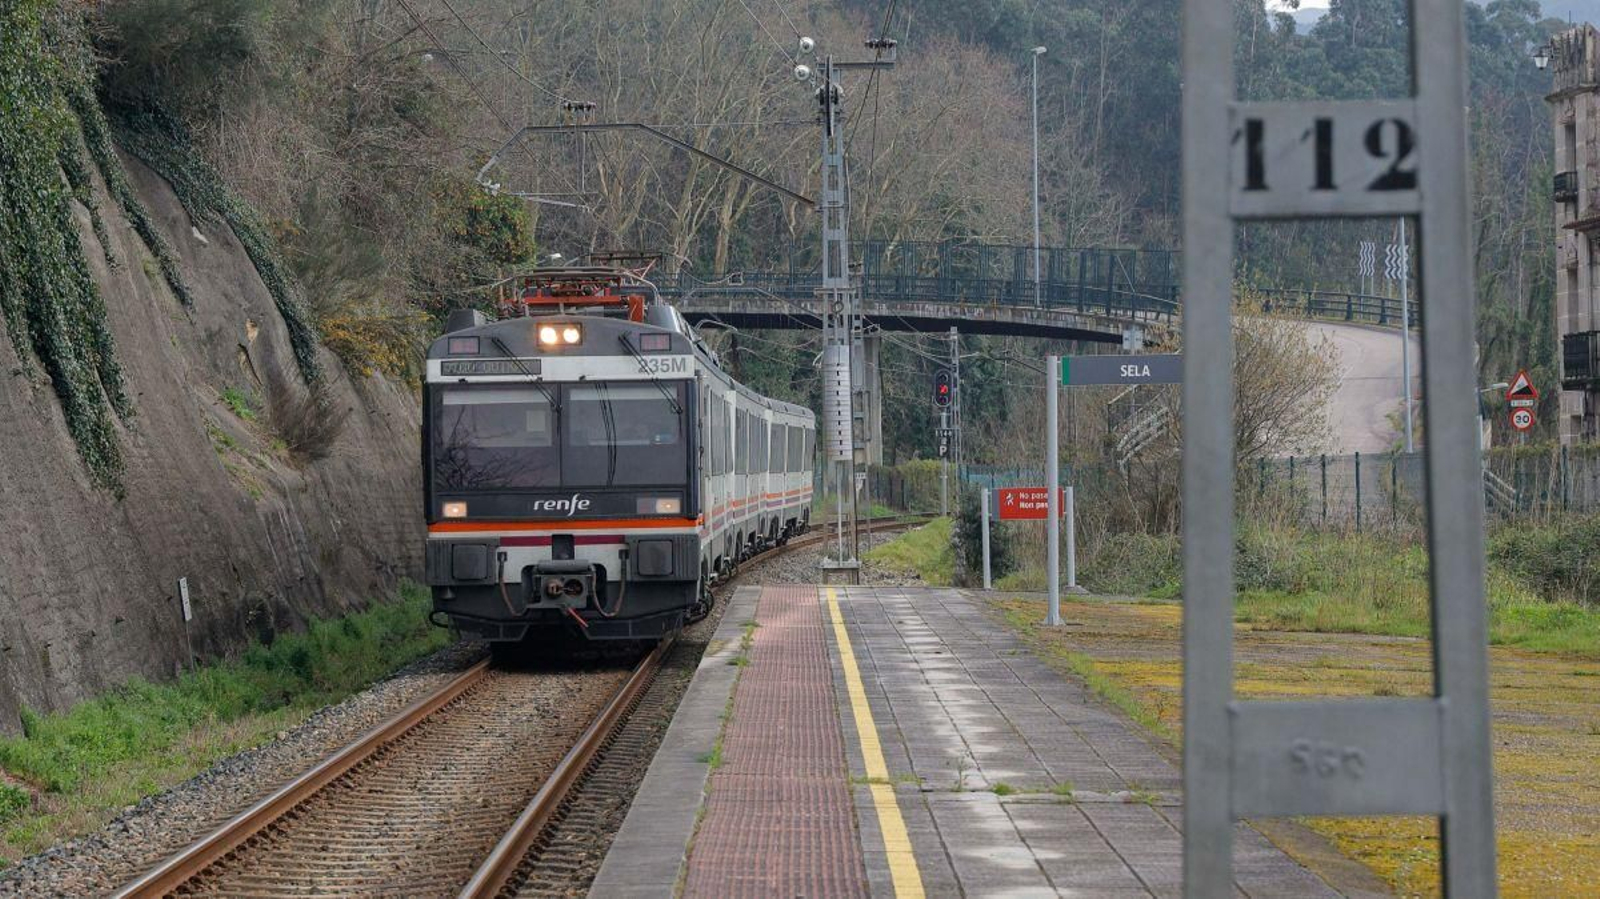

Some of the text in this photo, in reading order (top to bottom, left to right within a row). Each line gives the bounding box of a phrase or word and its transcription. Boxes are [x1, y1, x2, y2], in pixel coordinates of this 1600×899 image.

[1230, 117, 1417, 191] 112
[638, 357, 686, 373] 235M
[1120, 364, 1151, 377] SELA
[1515, 415, 1530, 424] 30
[1019, 492, 1049, 501] No pasa
[533, 493, 590, 517] renfe
[1019, 501, 1049, 510] Non pas
